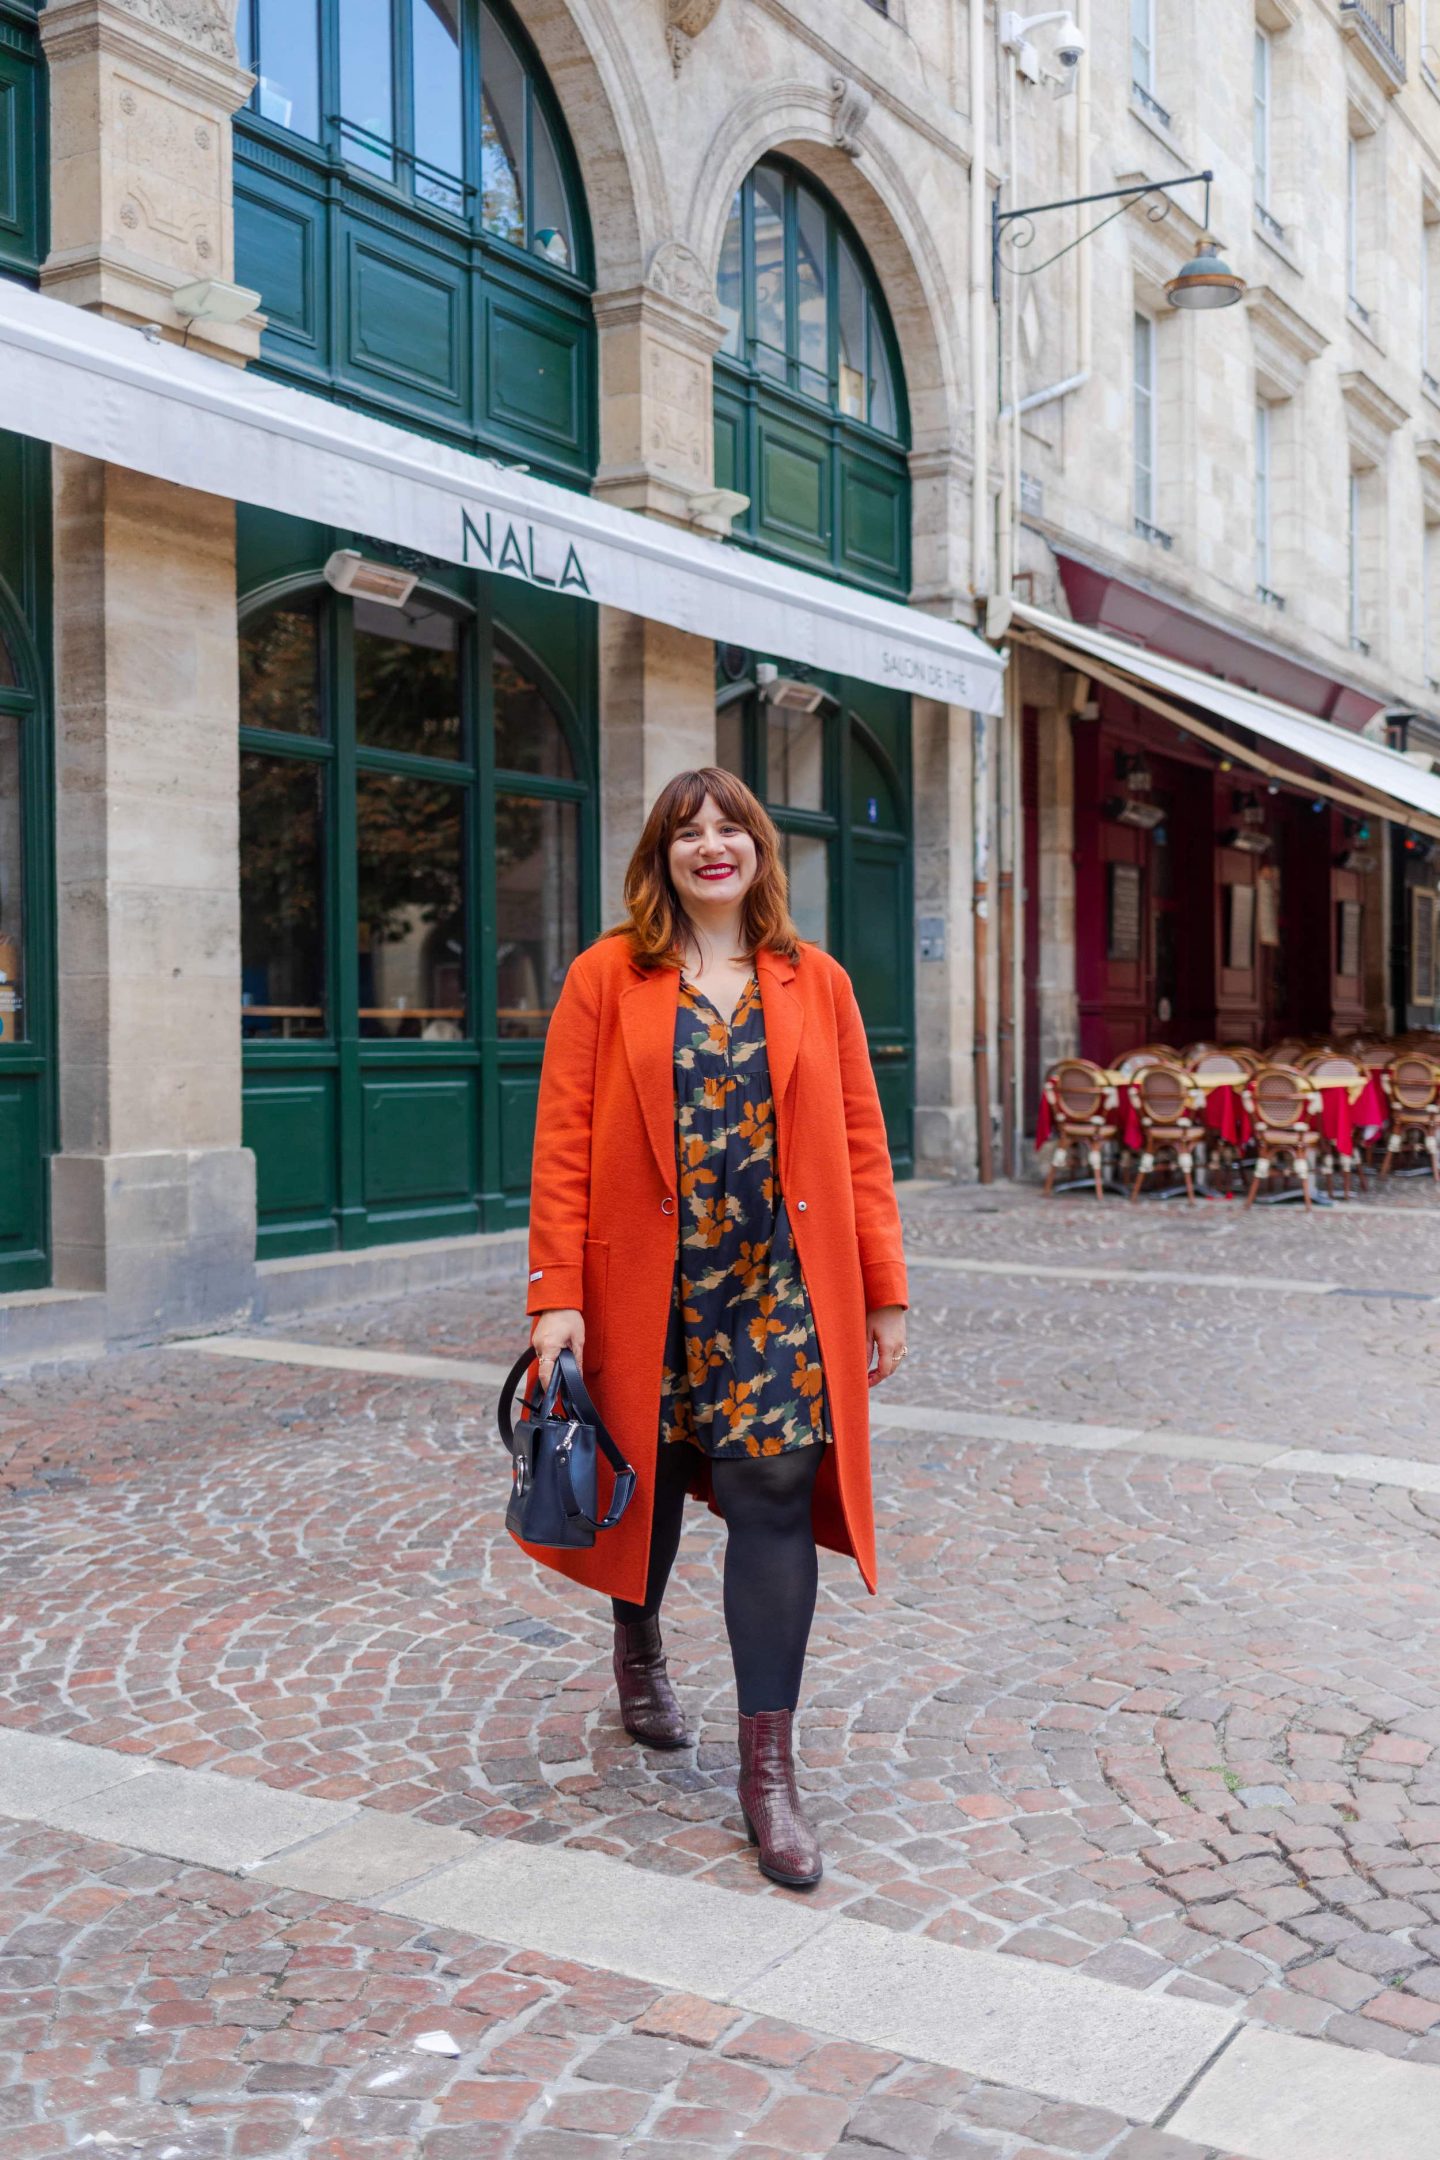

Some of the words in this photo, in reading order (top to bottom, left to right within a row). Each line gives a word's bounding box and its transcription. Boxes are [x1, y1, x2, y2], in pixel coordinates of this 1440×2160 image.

[461, 505, 591, 595] NALA
[882, 651, 926, 680] SALON
[927, 664, 944, 688] DE
